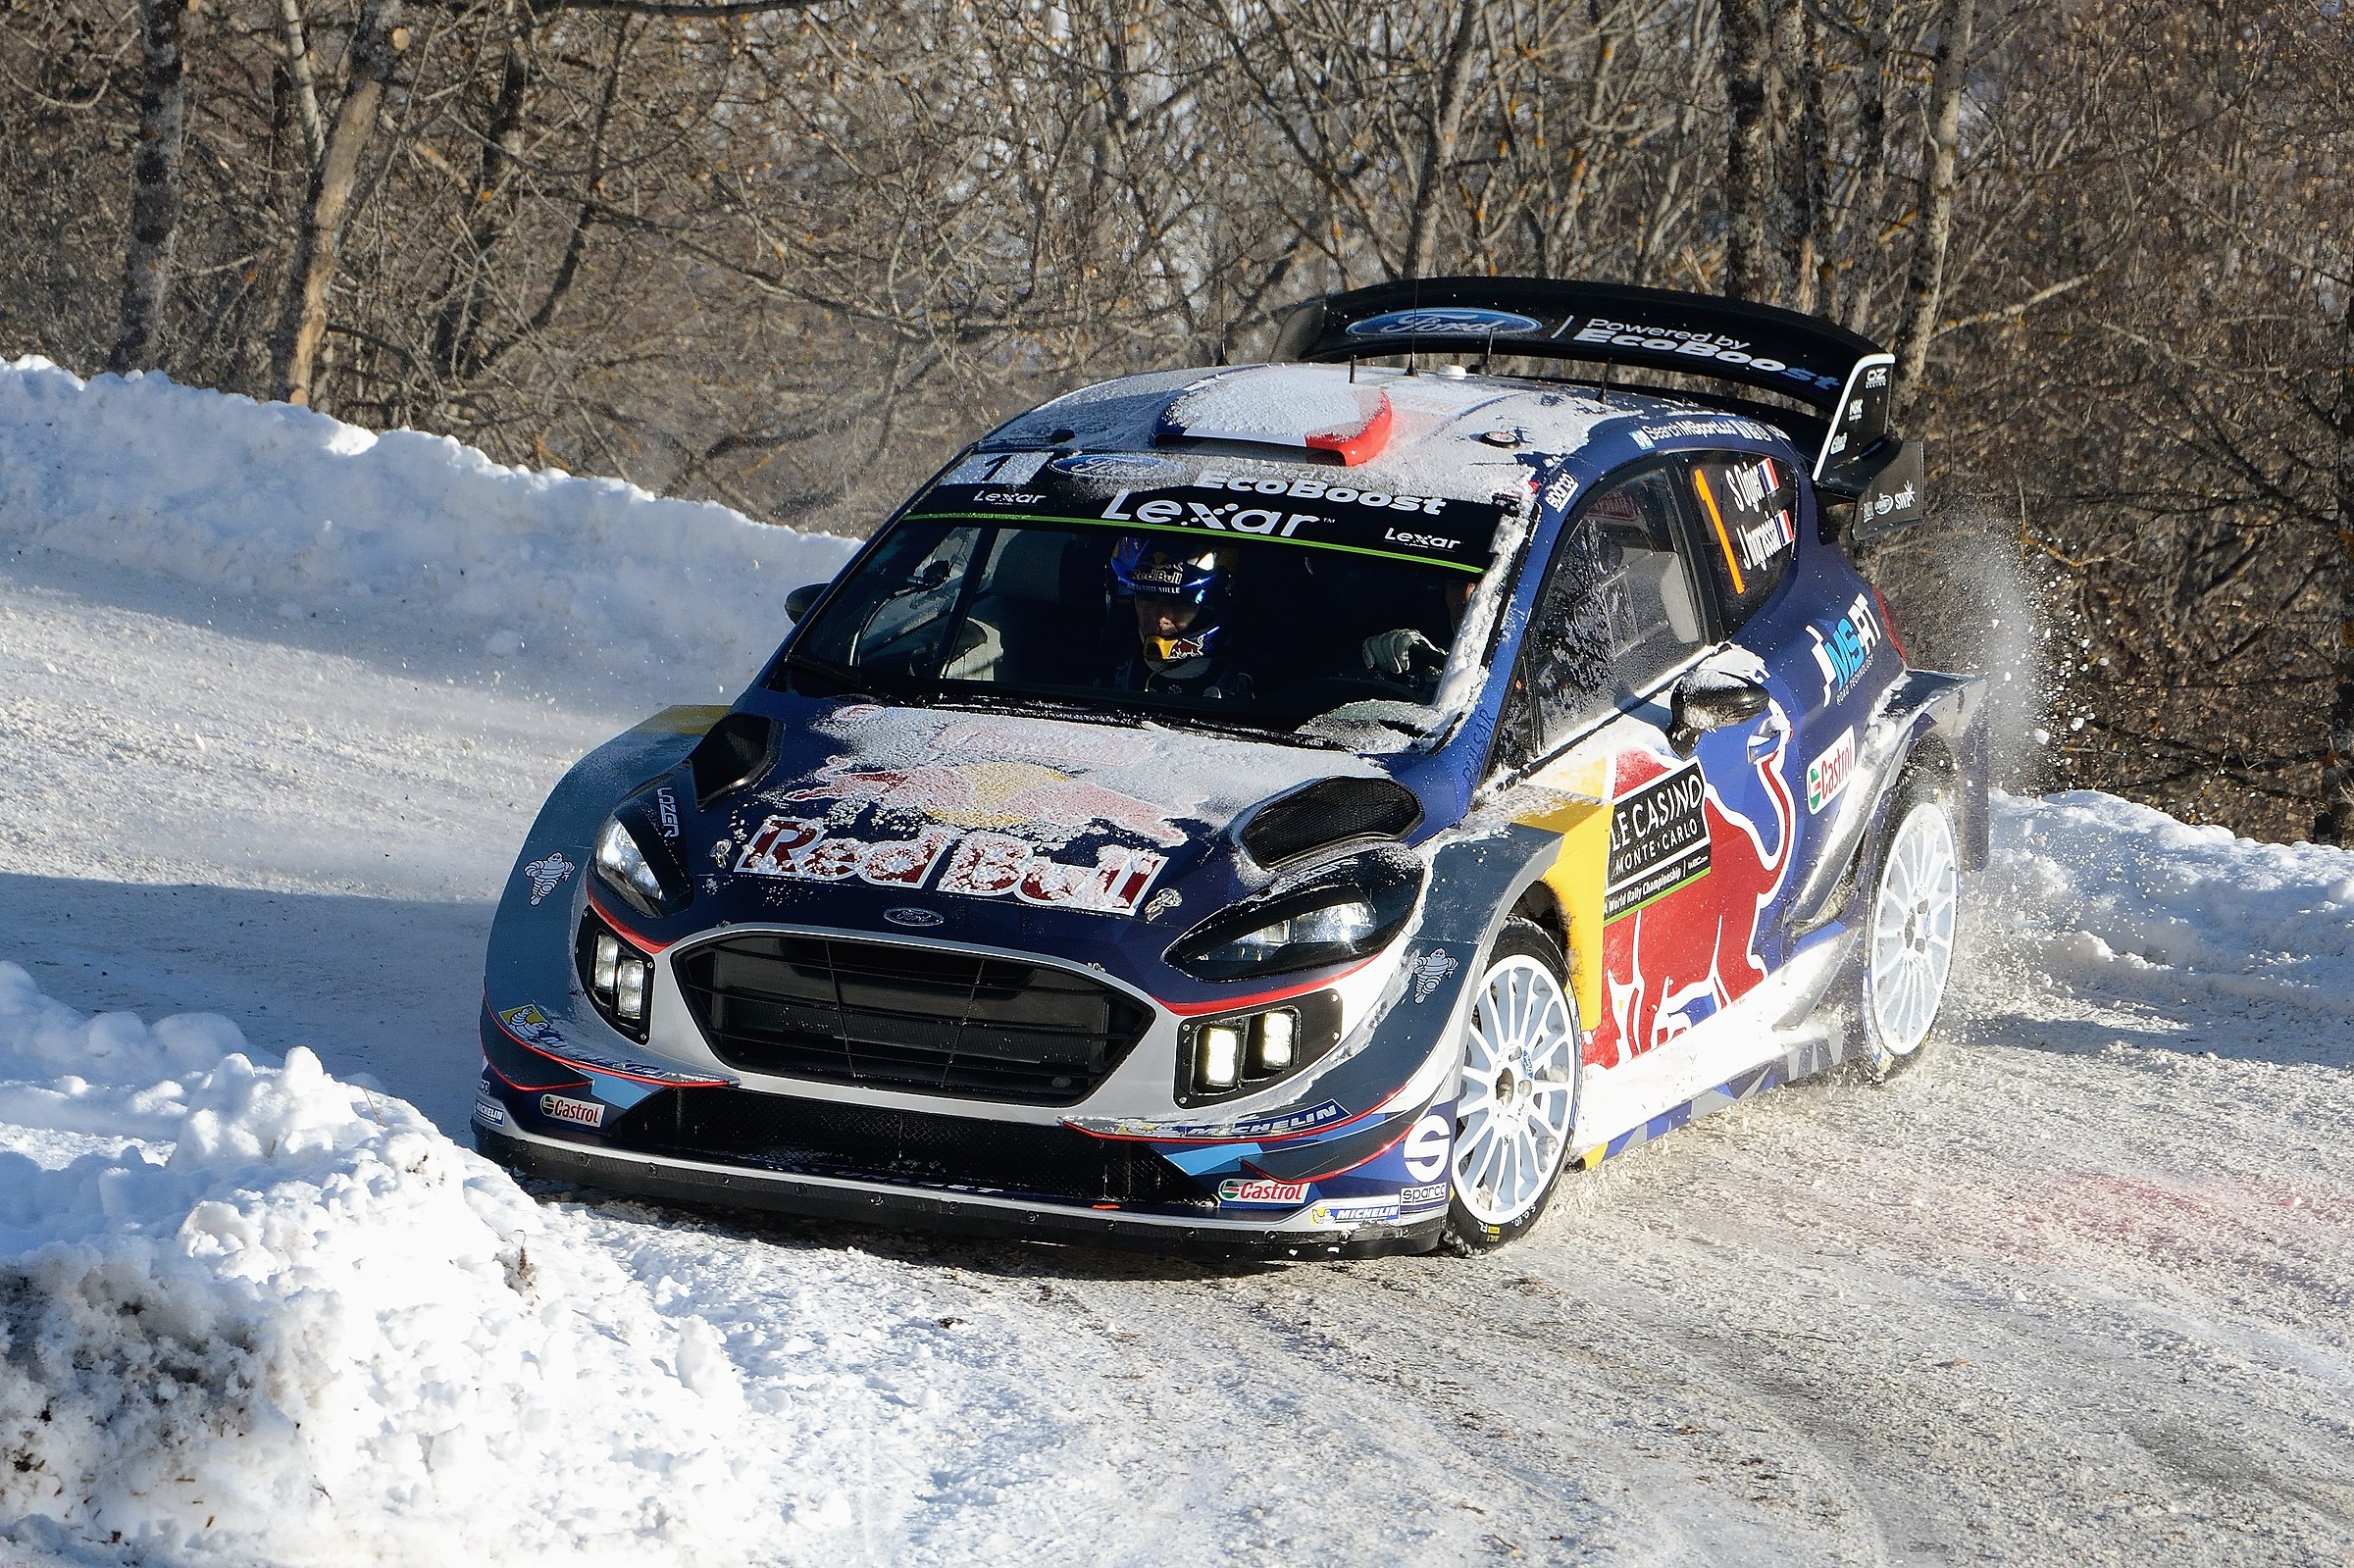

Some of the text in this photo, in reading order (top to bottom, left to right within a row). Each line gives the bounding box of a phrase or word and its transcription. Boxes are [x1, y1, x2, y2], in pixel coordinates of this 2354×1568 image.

[1379, 314, 1506, 333] Ford
[1586, 318, 1751, 351] Powered by
[1572, 328, 1841, 390] EcoBoost
[1867, 368, 1888, 381] OZ
[981, 454, 1012, 481] 1
[973, 489, 1047, 504] Lexar
[1192, 469, 1447, 515] EcoBoost
[1545, 472, 1578, 511] sparco
[1724, 461, 1766, 514] S Ogier
[1100, 487, 1320, 537] Lexar
[1384, 527, 1461, 549] Lexar
[1694, 468, 1746, 595] 1
[1131, 569, 1183, 584] Red Bull
[1819, 735, 1853, 801] Castrol
[1610, 774, 1705, 852] LE CASINO
[734, 816, 1170, 917] Red Bull
[554, 1097, 600, 1125] Castrol
[1240, 1182, 1304, 1200] Castrol
[1335, 1205, 1399, 1220] MICHELIN
